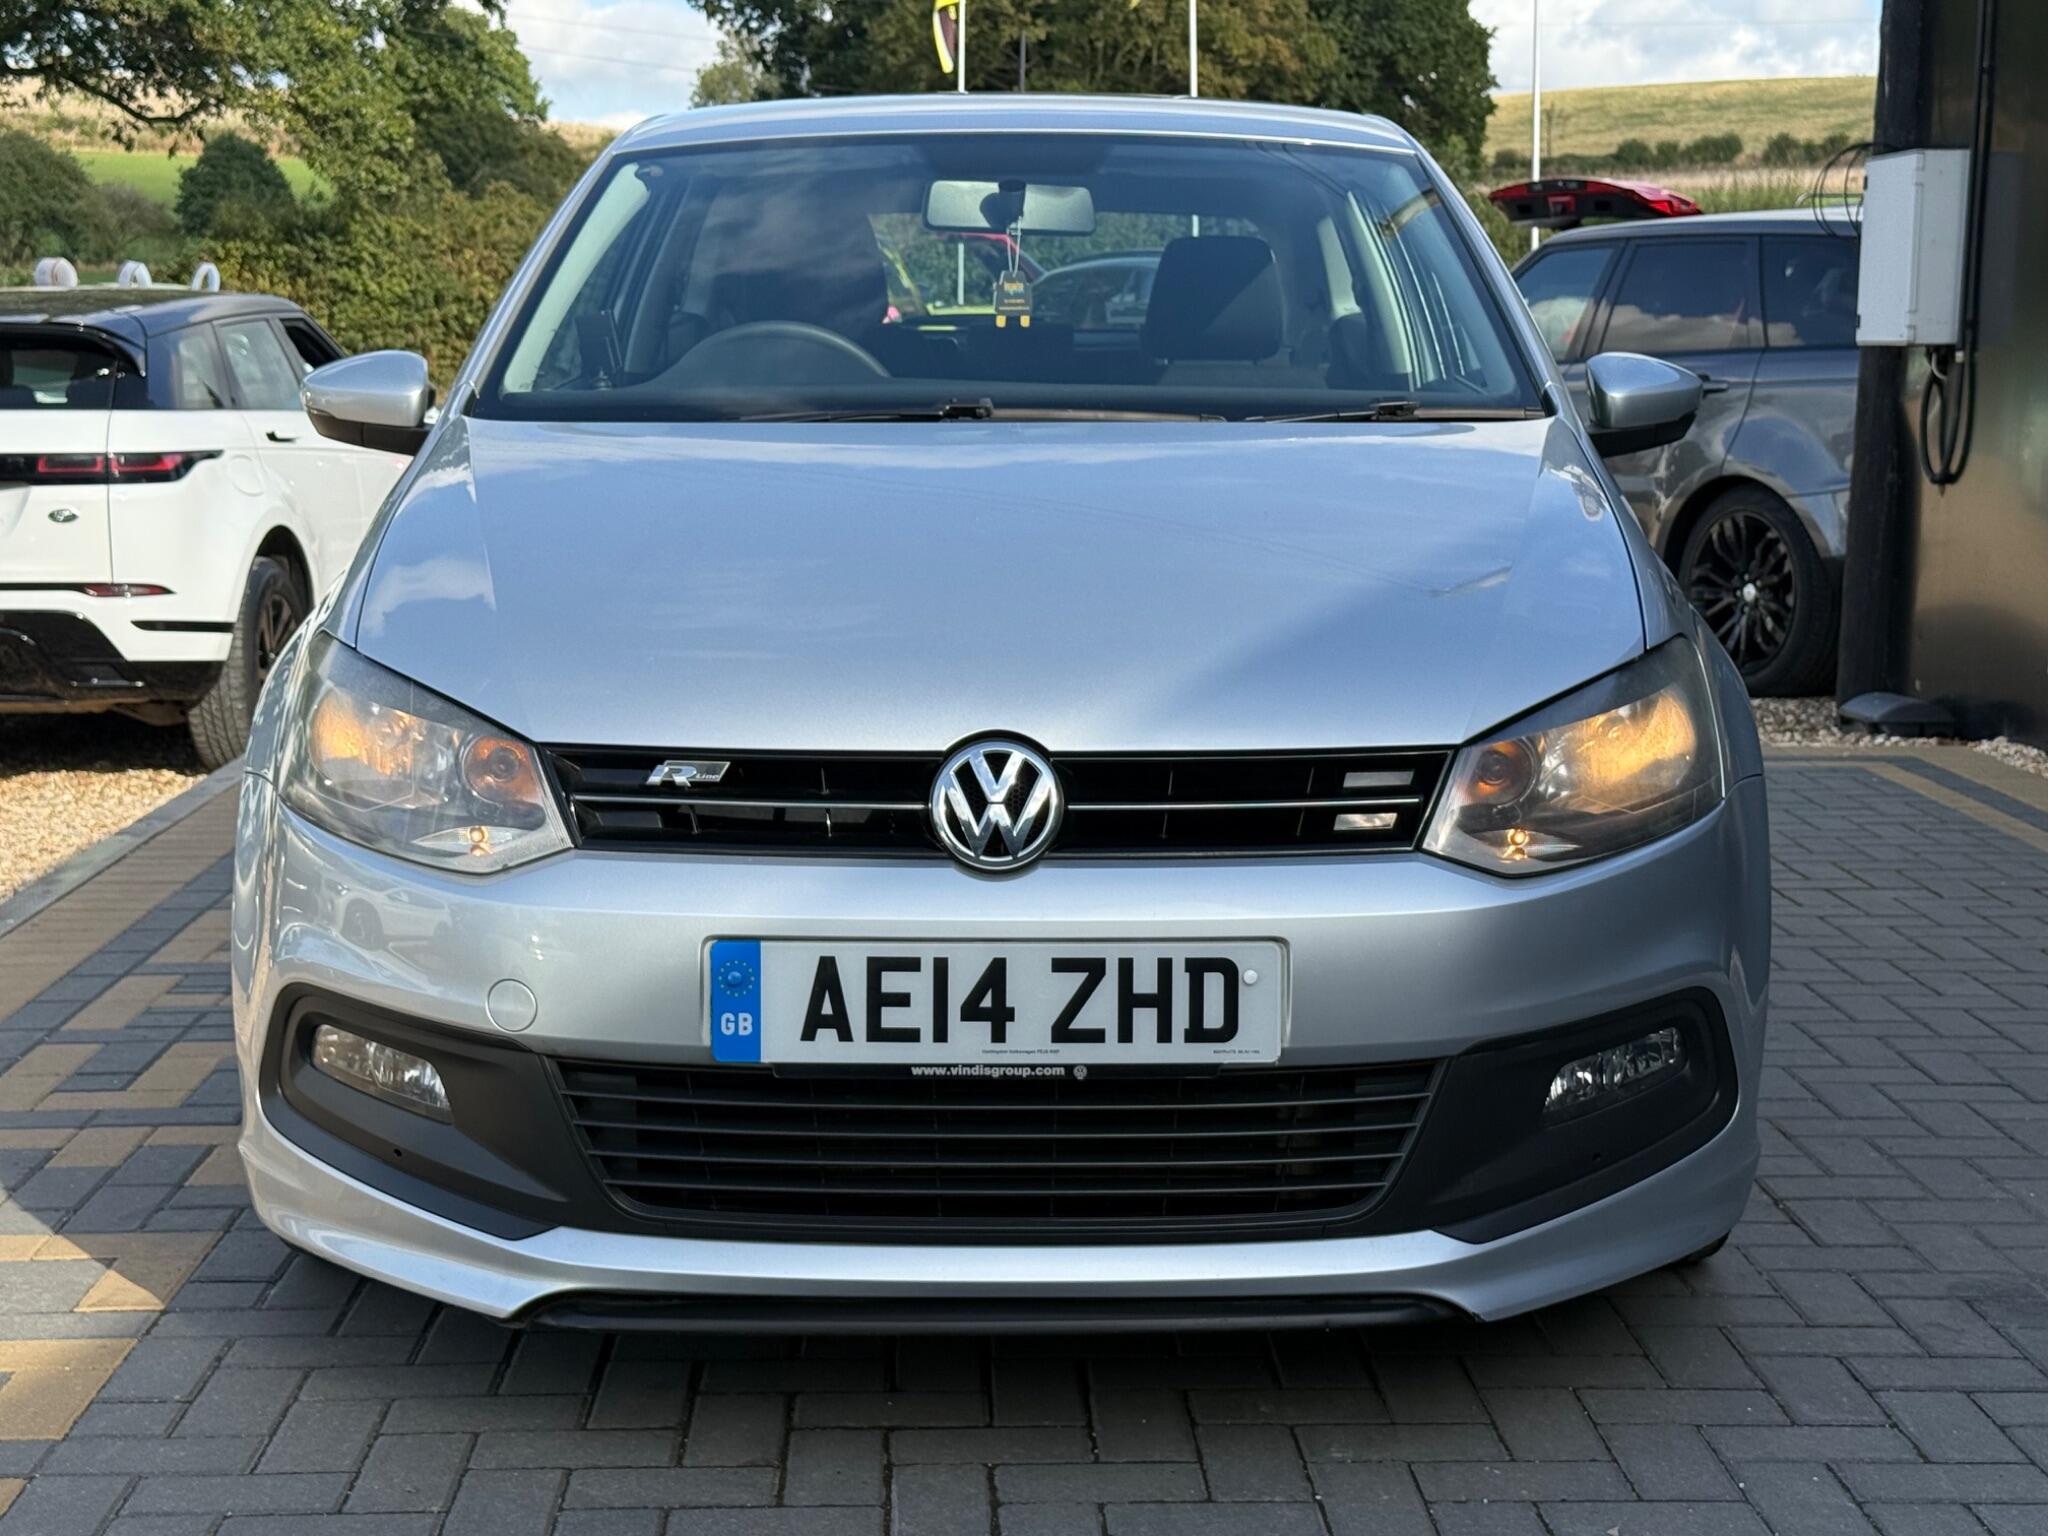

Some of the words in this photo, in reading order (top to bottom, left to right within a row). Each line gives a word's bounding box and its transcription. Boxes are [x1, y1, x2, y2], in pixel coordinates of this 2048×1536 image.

[800, 955, 1015, 1043] AE14
[1051, 957, 1239, 1043] ZHD
[720, 1012, 753, 1036] GB
[911, 1065, 1065, 1078] www.vindisgroup.com
